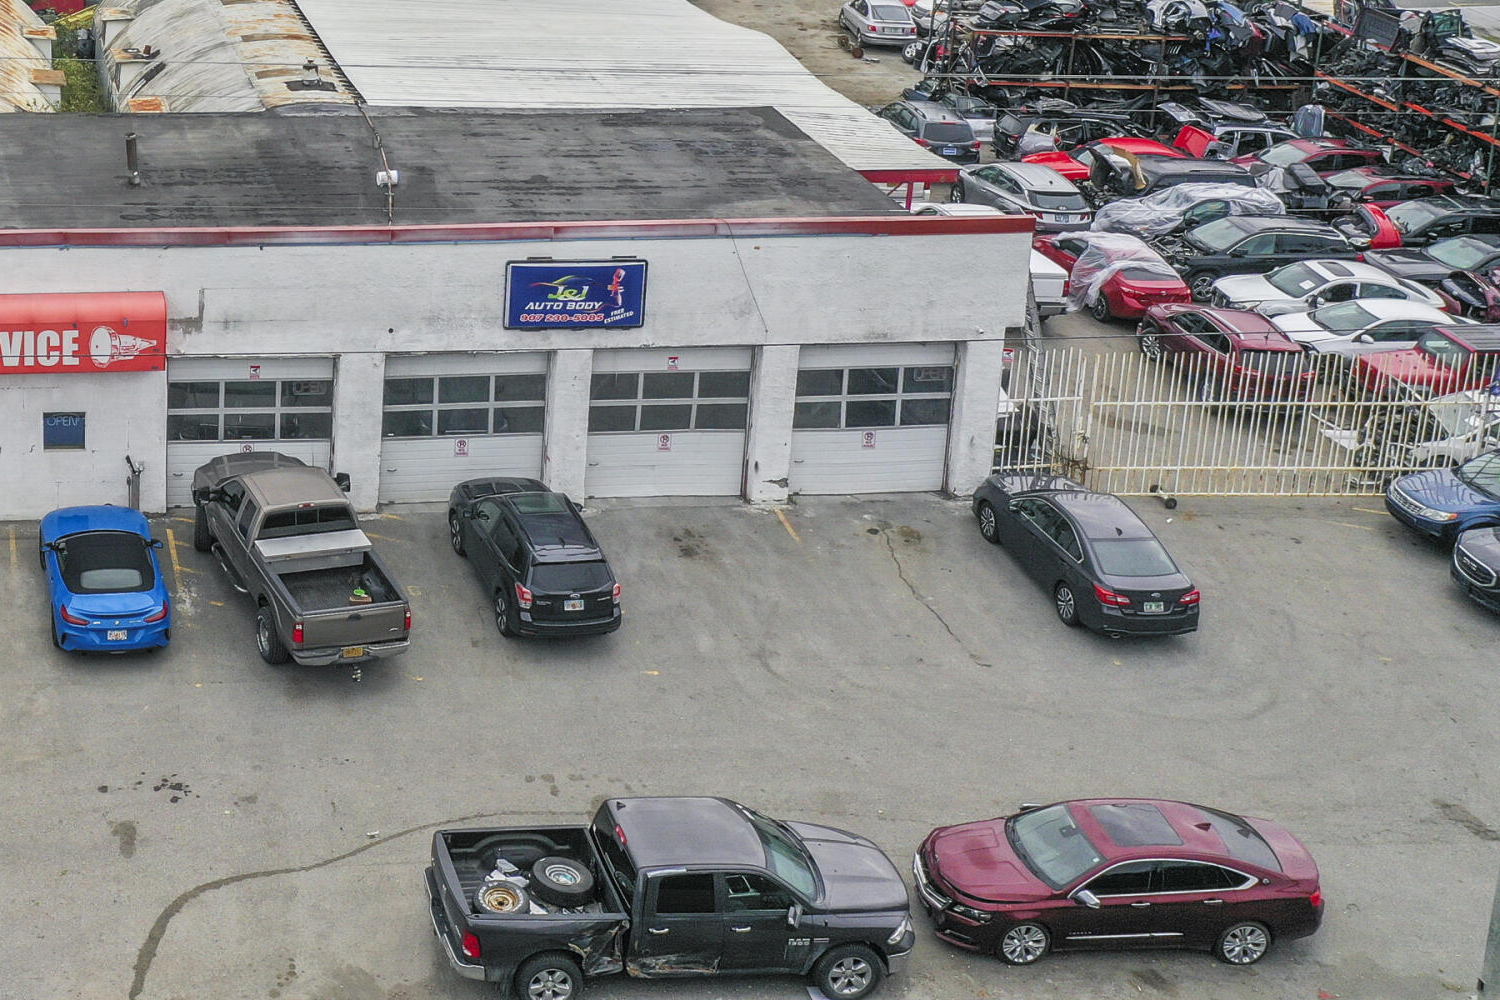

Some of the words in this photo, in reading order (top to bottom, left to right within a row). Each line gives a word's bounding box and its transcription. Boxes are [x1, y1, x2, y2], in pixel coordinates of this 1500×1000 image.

[525, 302, 563, 310] AUTO
[566, 301, 603, 310] BODY
[611, 308, 624, 316] FREE
[520, 314, 544, 323] 907
[604, 311, 634, 324] ESTIMATED
[46, 416, 77, 426] OPEN
